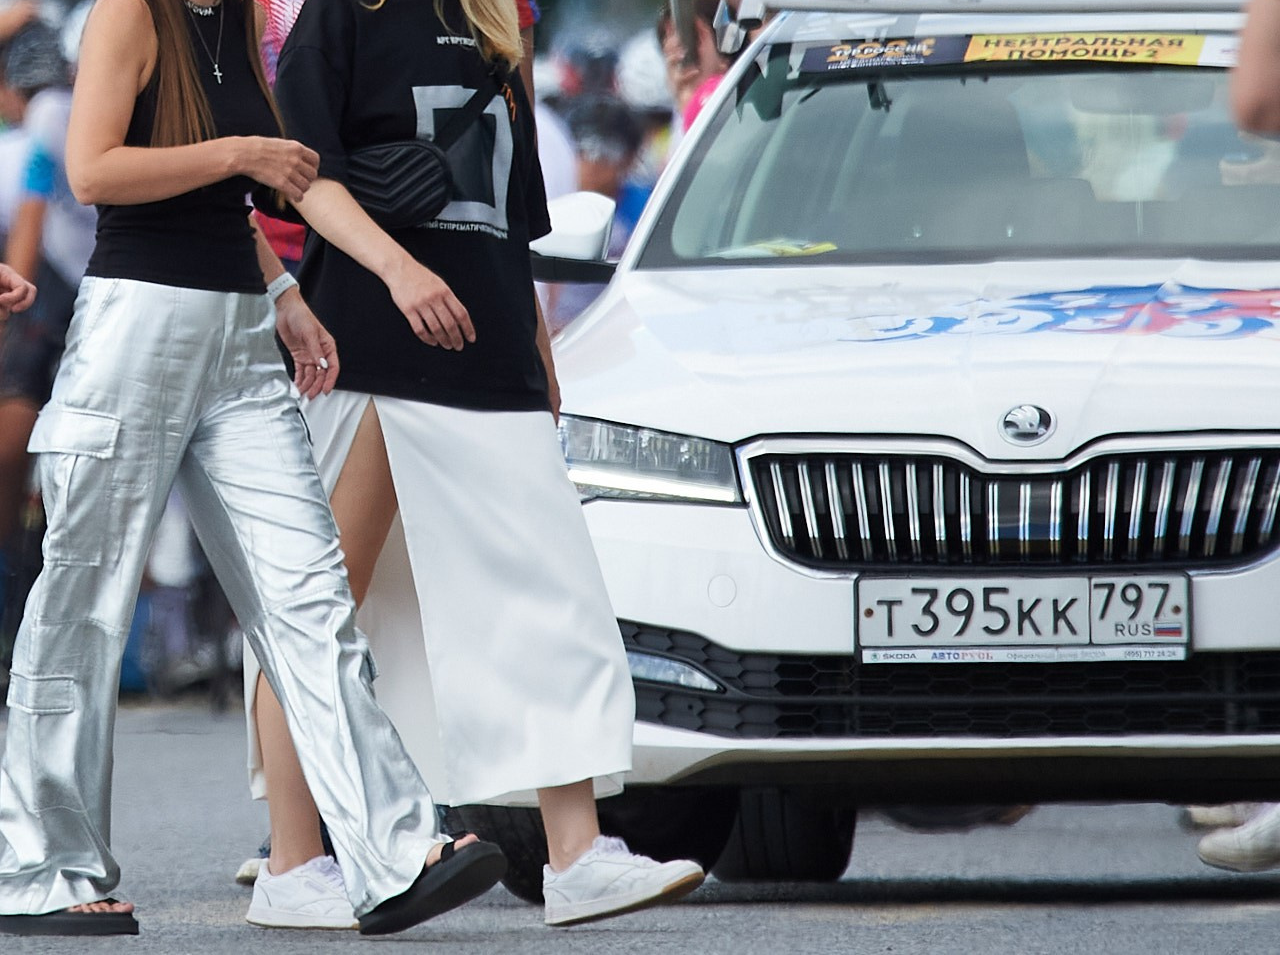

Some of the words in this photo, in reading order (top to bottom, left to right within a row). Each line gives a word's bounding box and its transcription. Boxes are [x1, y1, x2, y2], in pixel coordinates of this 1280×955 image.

[984, 36, 1185, 49] НЕЙТРАЛЬНАЯ
[1007, 48, 1137, 60] ПОМОЩЬ
[1147, 49, 1158, 58] 2
[1093, 583, 1171, 621] 797
[1114, 622, 1152, 638] RUS
